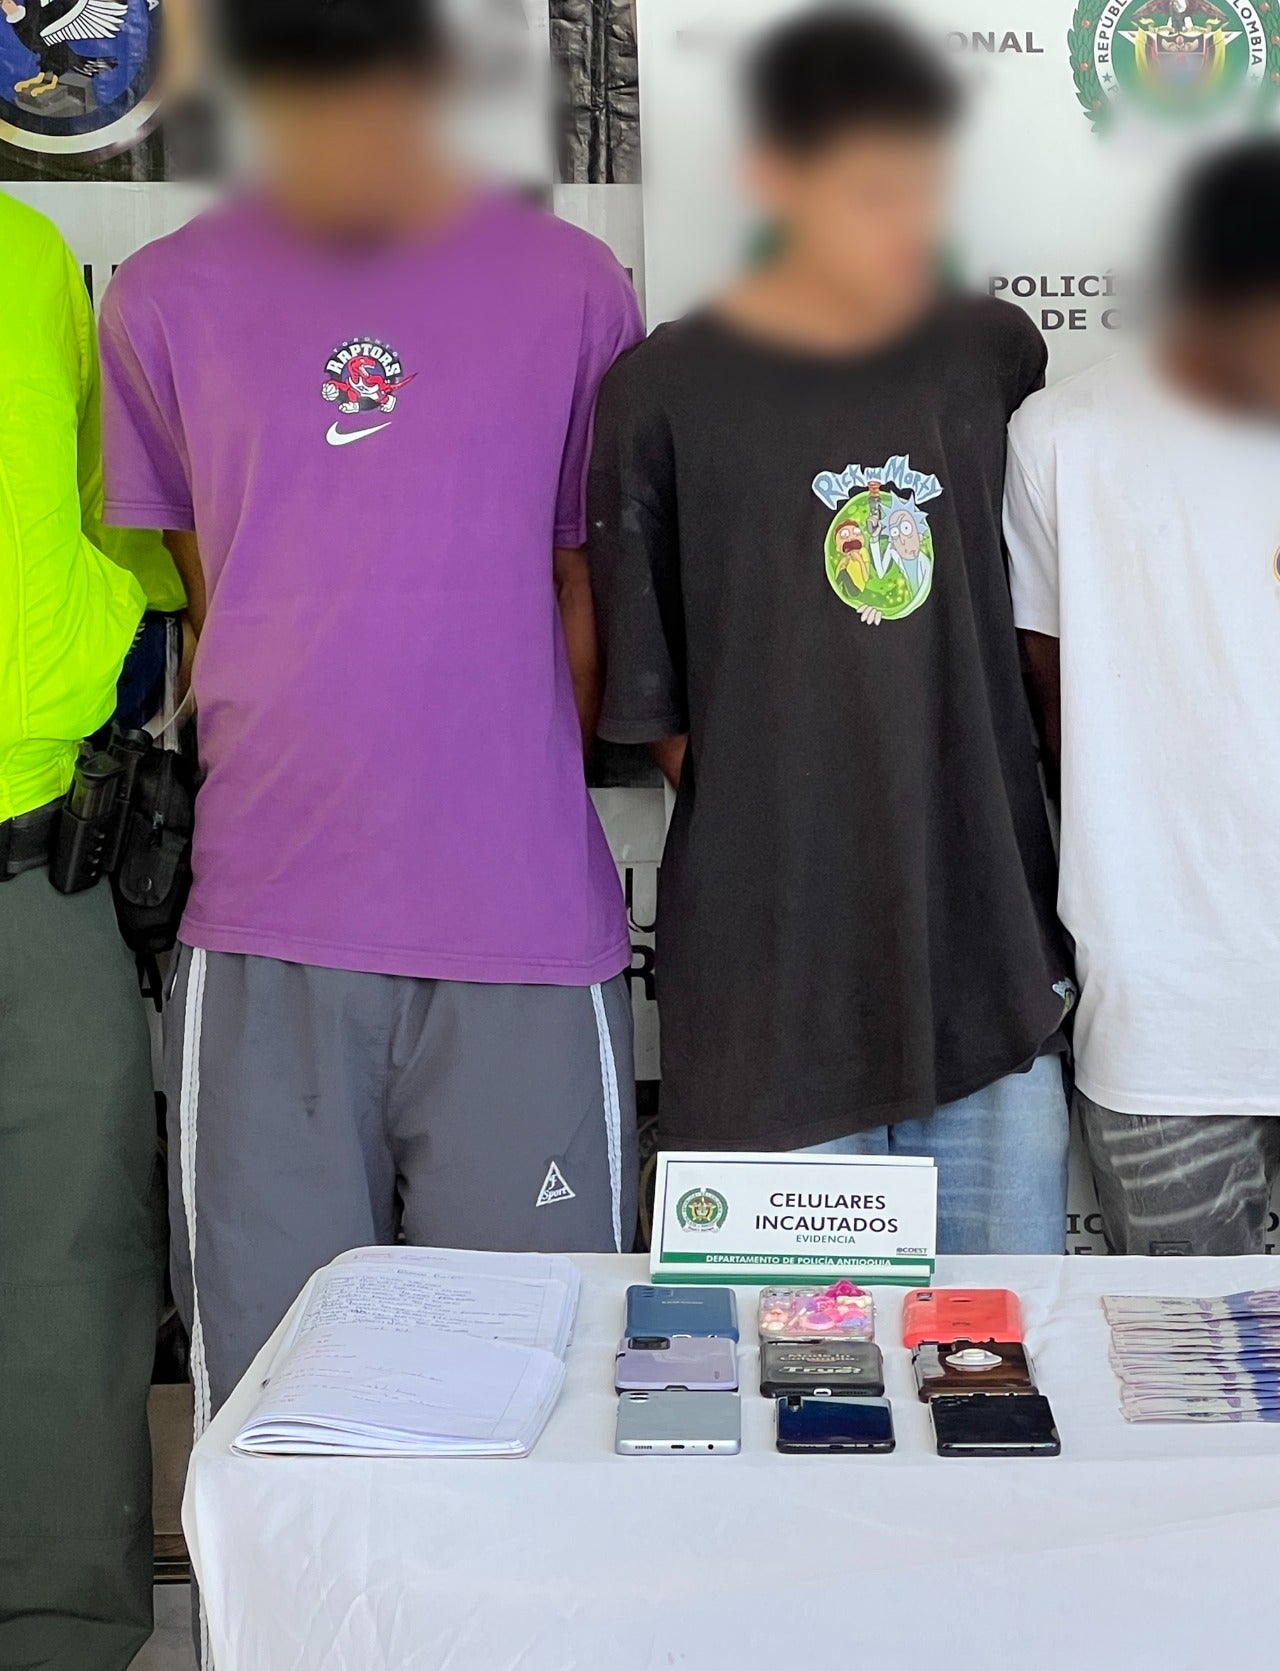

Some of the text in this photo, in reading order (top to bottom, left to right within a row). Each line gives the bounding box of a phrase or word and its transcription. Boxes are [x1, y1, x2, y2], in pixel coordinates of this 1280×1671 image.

[946, 31, 1044, 53] ONAL
[1097, 0, 1263, 66] REPÚBL LOMBIA
[988, 268, 1118, 297] POLICÍ
[1041, 308, 1088, 330] DE
[326, 343, 401, 377] RAPTORS
[769, 1192, 886, 1210] CELULARES
[755, 1215, 898, 1233] INCAUTADOS
[796, 1234, 856, 1244] EVIDENCIA
[705, 1254, 780, 1265] DEPARTAMENTO
[782, 1255, 796, 1265] DE
[797, 1255, 835, 1266] POLICÍA
